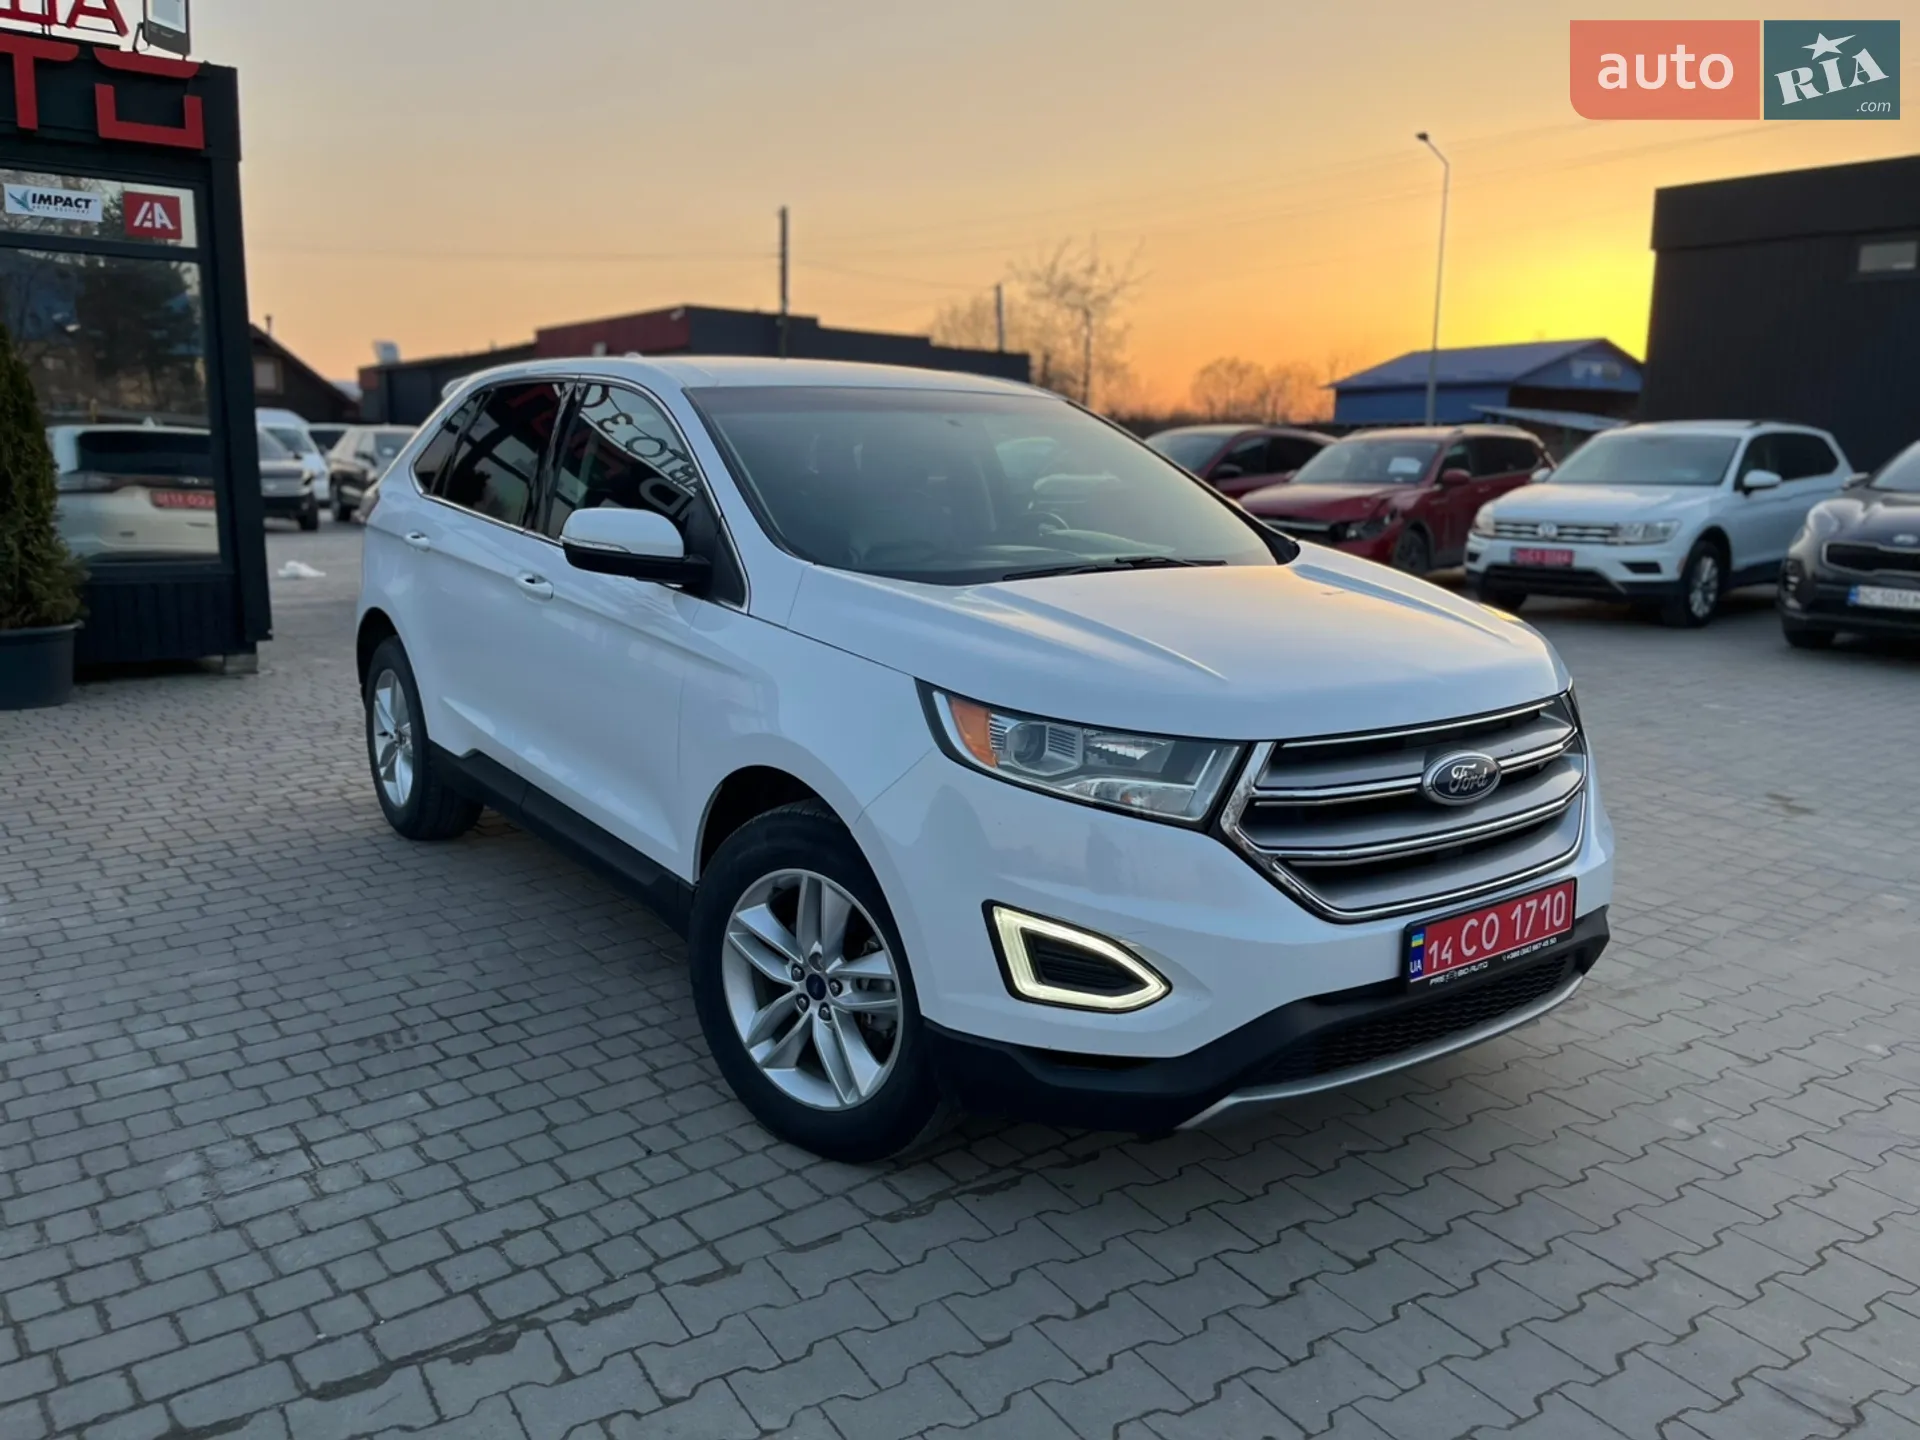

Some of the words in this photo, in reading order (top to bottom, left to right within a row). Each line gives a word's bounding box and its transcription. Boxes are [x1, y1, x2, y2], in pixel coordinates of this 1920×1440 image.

[32, 192, 92, 209] IMPACT
[1449, 763, 1488, 793] Ford
[1428, 935, 1453, 969] 14
[1460, 912, 1500, 957] CO
[1510, 890, 1566, 941] 1710
[1409, 959, 1423, 974] UA
